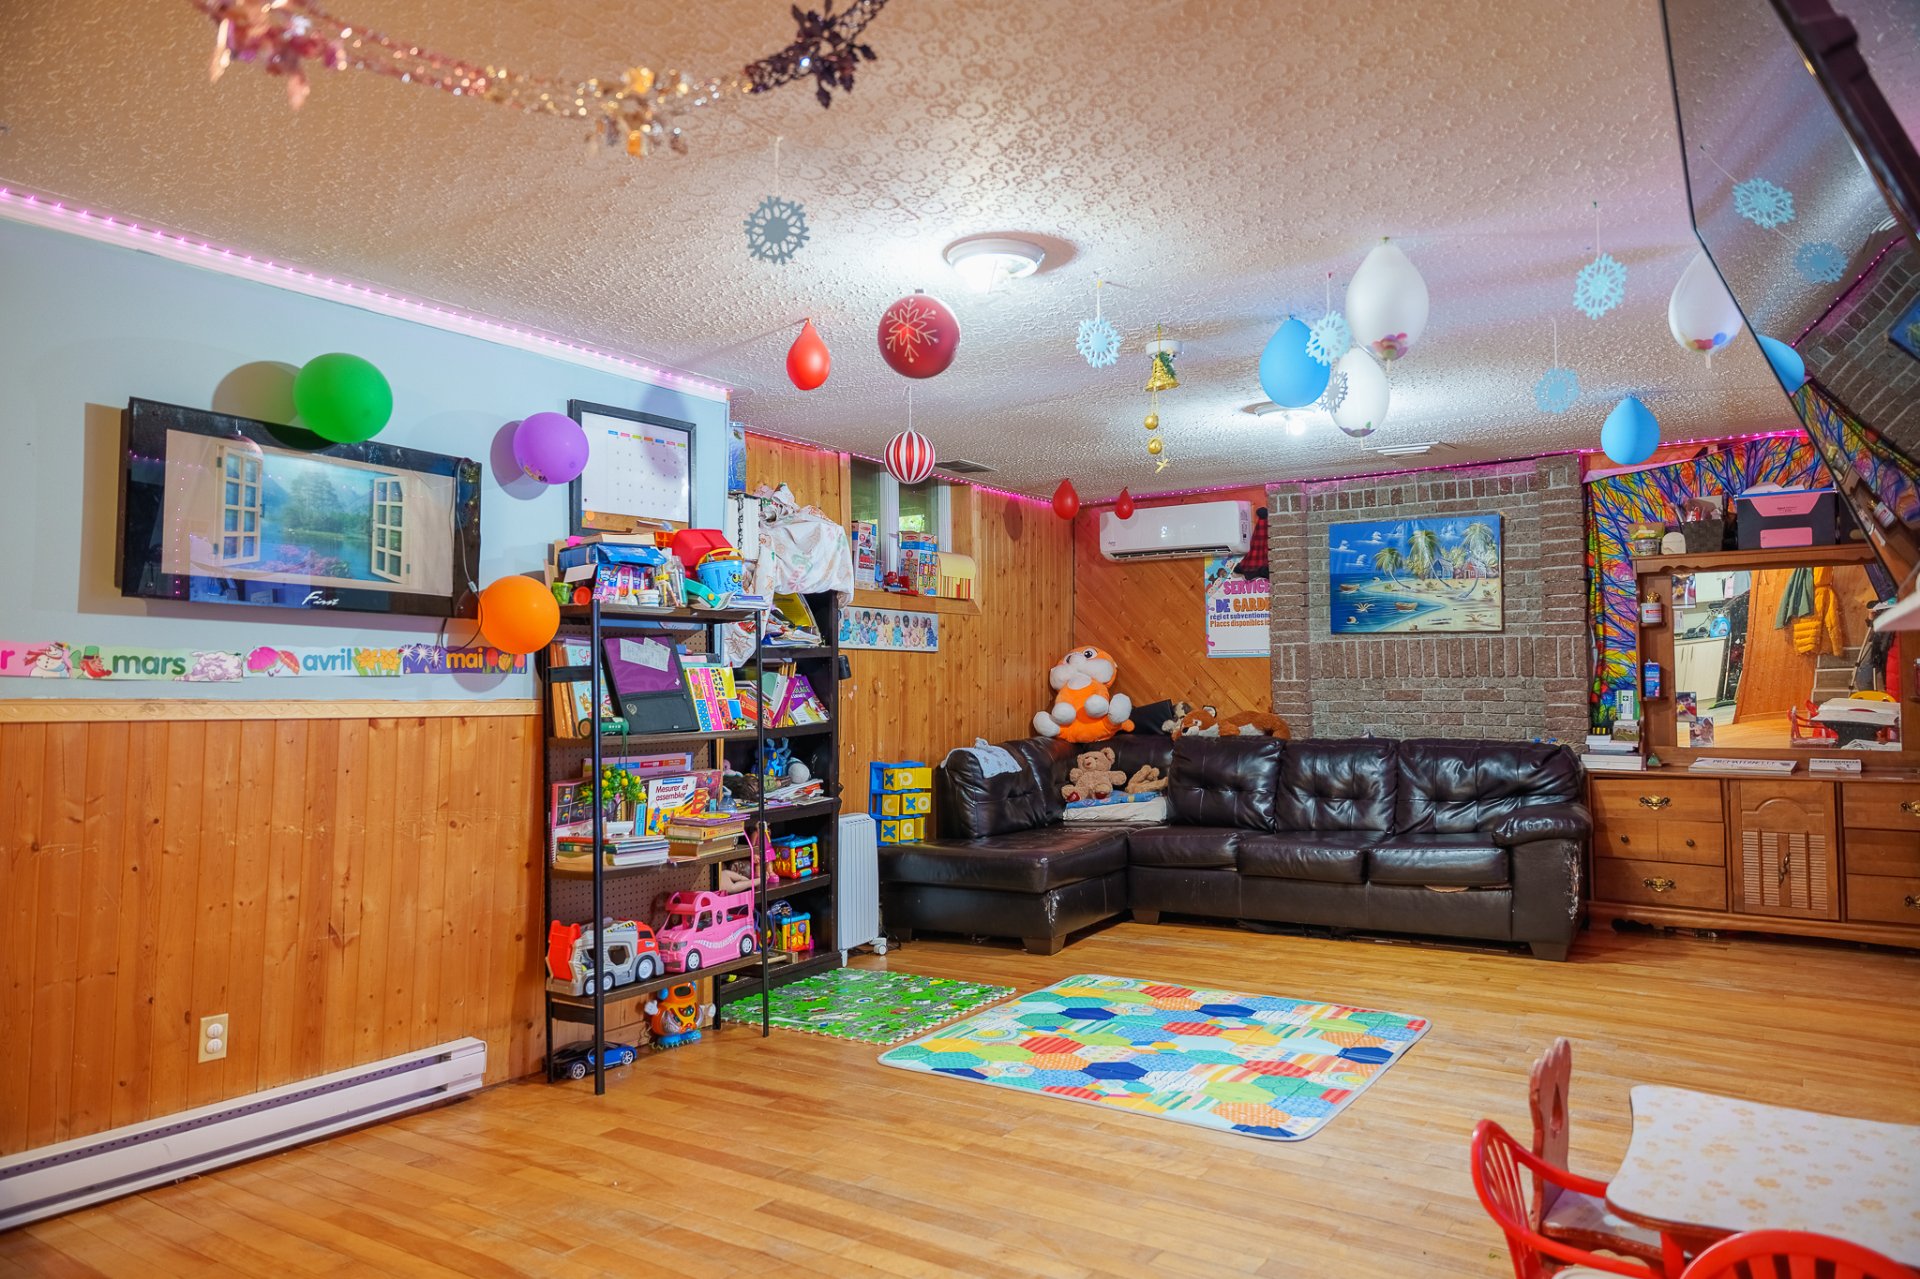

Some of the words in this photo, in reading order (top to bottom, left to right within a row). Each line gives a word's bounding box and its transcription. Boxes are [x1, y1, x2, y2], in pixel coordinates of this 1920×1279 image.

[301, 590, 340, 606] First
[1216, 599, 1230, 613] DE
[112, 655, 186, 675] mars
[303, 648, 352, 671] avril
[446, 647, 483, 669] mai
[656, 785, 680, 793] Mesurer
[681, 783, 688, 791] et
[656, 792, 685, 801] assembler
